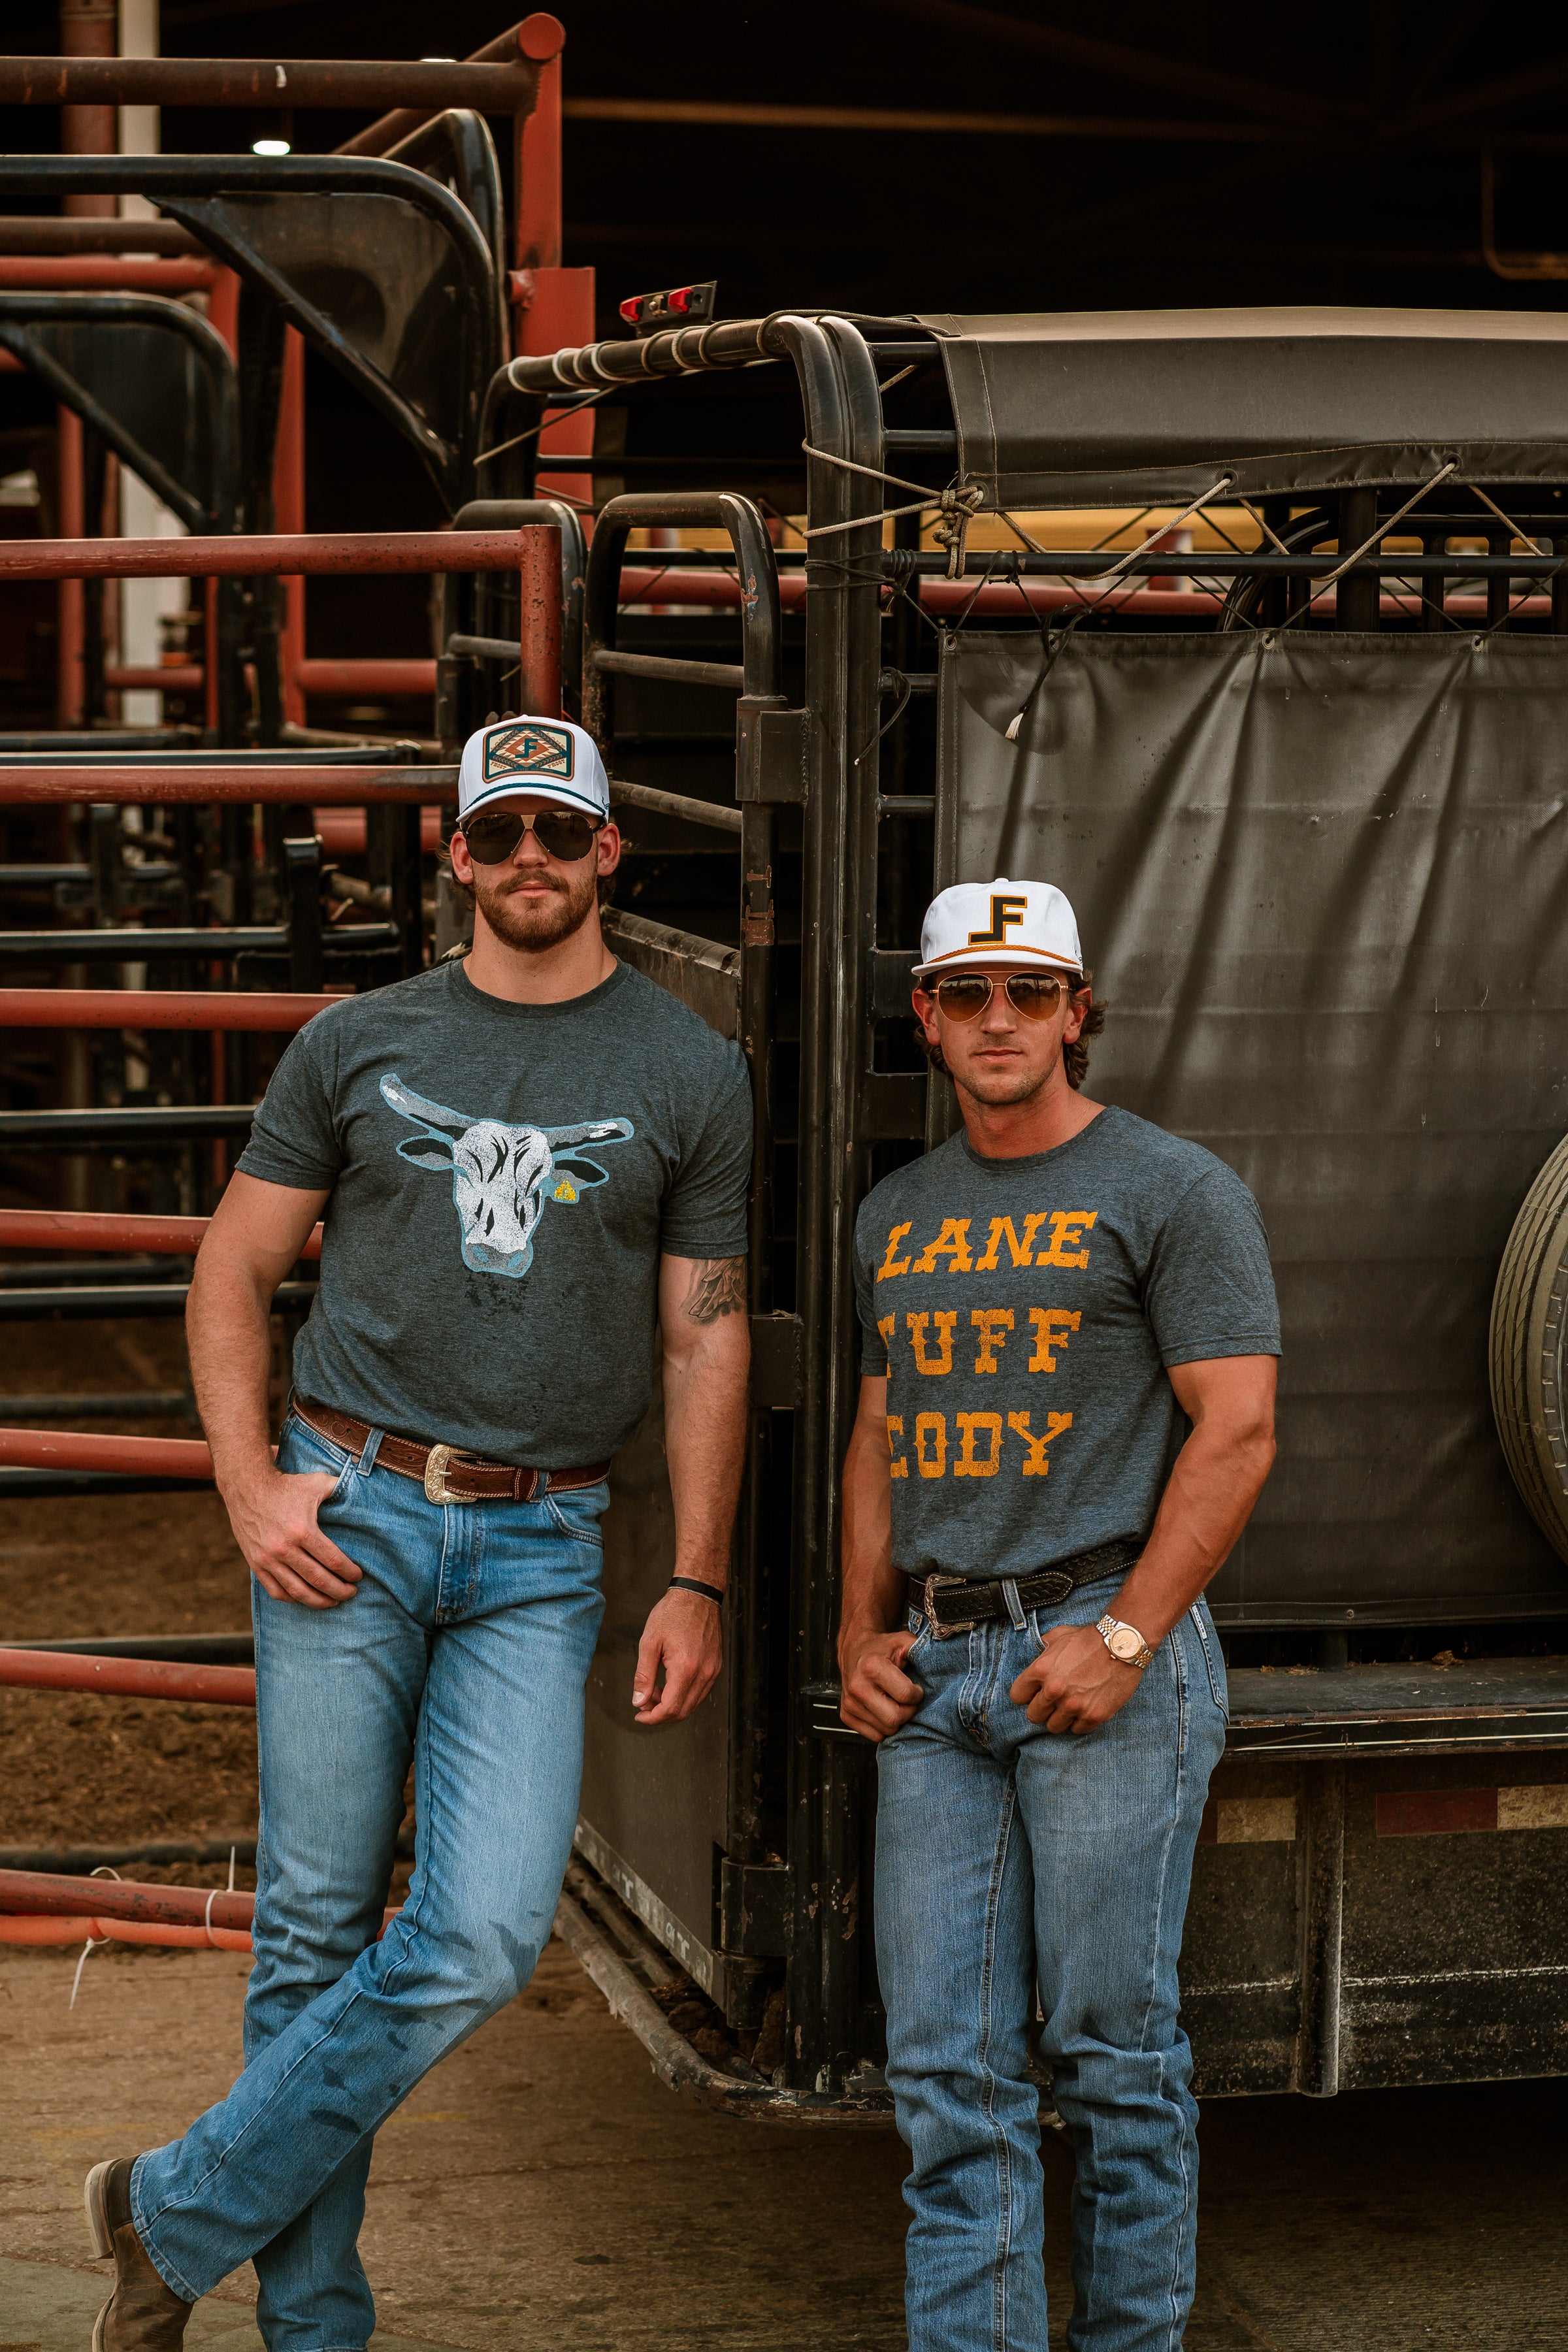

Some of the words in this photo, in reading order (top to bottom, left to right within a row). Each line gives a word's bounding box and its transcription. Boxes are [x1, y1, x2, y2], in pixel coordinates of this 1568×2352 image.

[490, 761, 507, 770] FROST
[547, 759, 565, 768] FROST
[876, 1211, 1098, 1283] LANE
